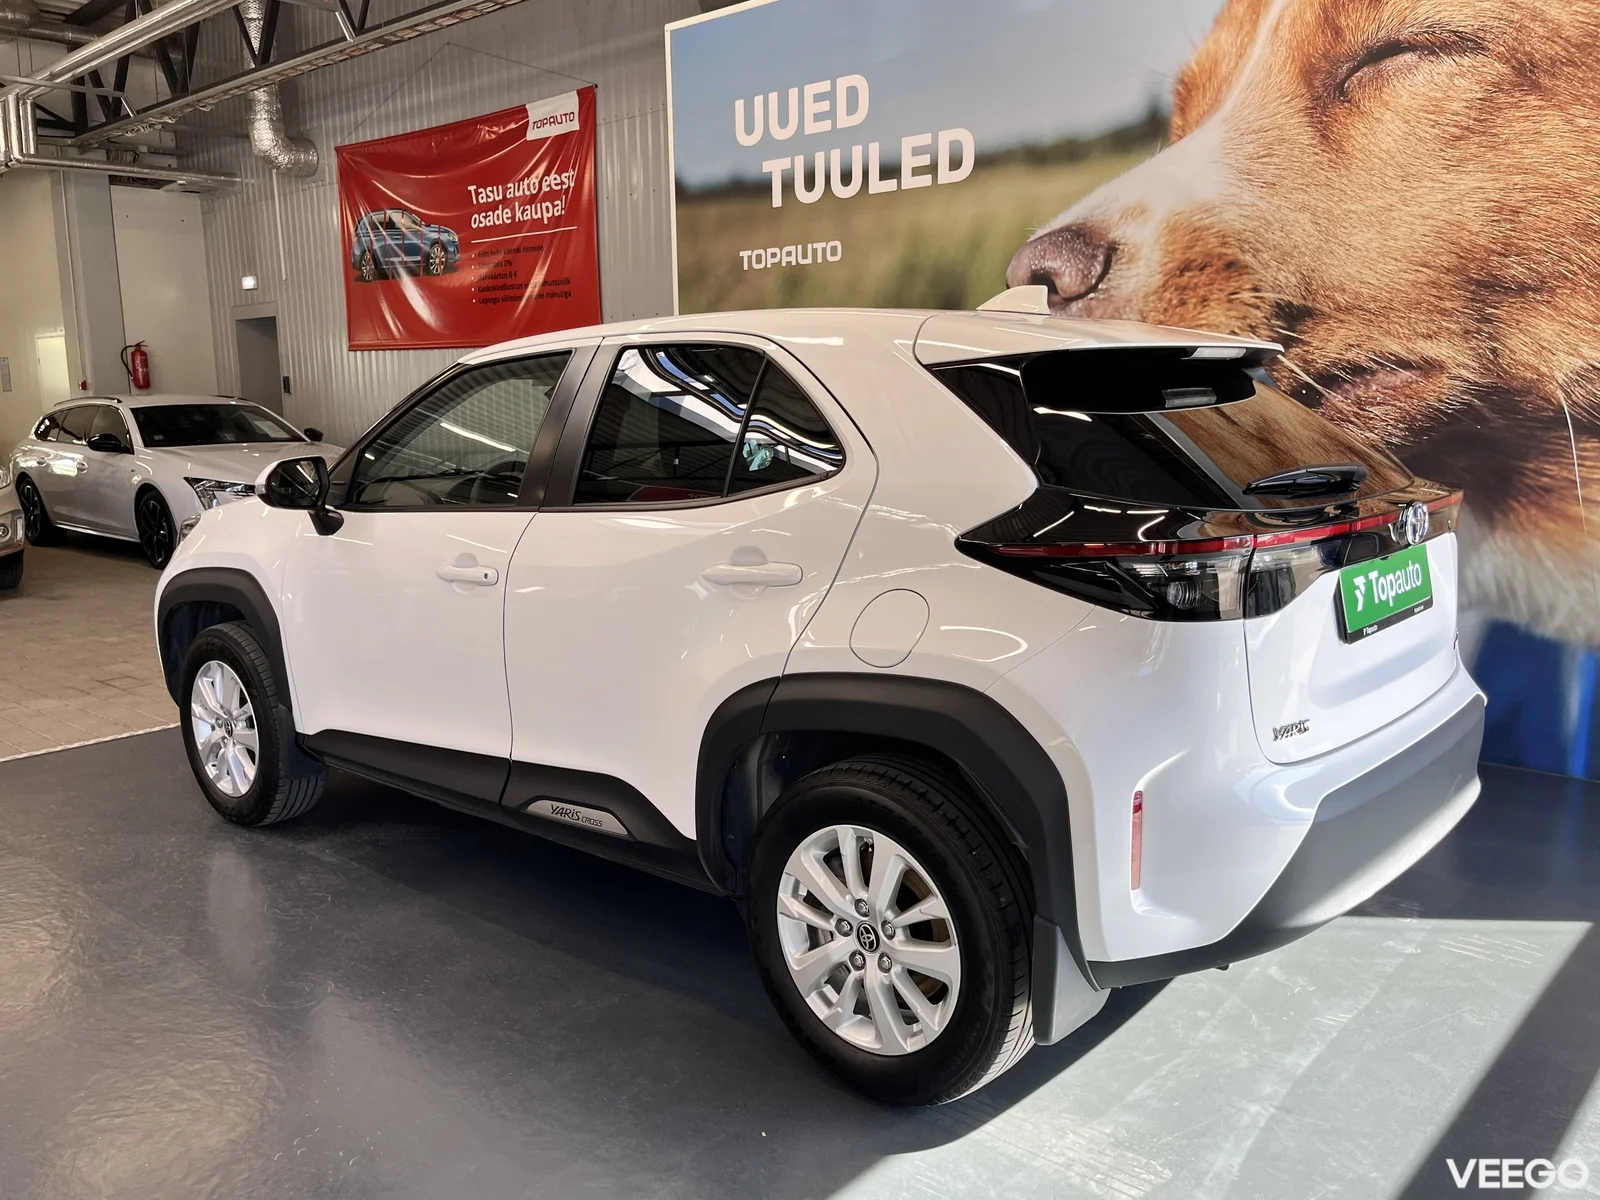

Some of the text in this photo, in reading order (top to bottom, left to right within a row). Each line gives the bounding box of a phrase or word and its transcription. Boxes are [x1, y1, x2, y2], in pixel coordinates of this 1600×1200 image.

[532, 111, 575, 130] TOPAUTO
[735, 74, 869, 147] UUED
[762, 127, 975, 208] TUULED
[467, 168, 575, 205] Tasu auto eest
[470, 194, 566, 229] osade kaupa!
[739, 240, 842, 271] TOPAUTO
[1368, 560, 1422, 607] Topauto
[580, 815, 603, 828] CROSS
